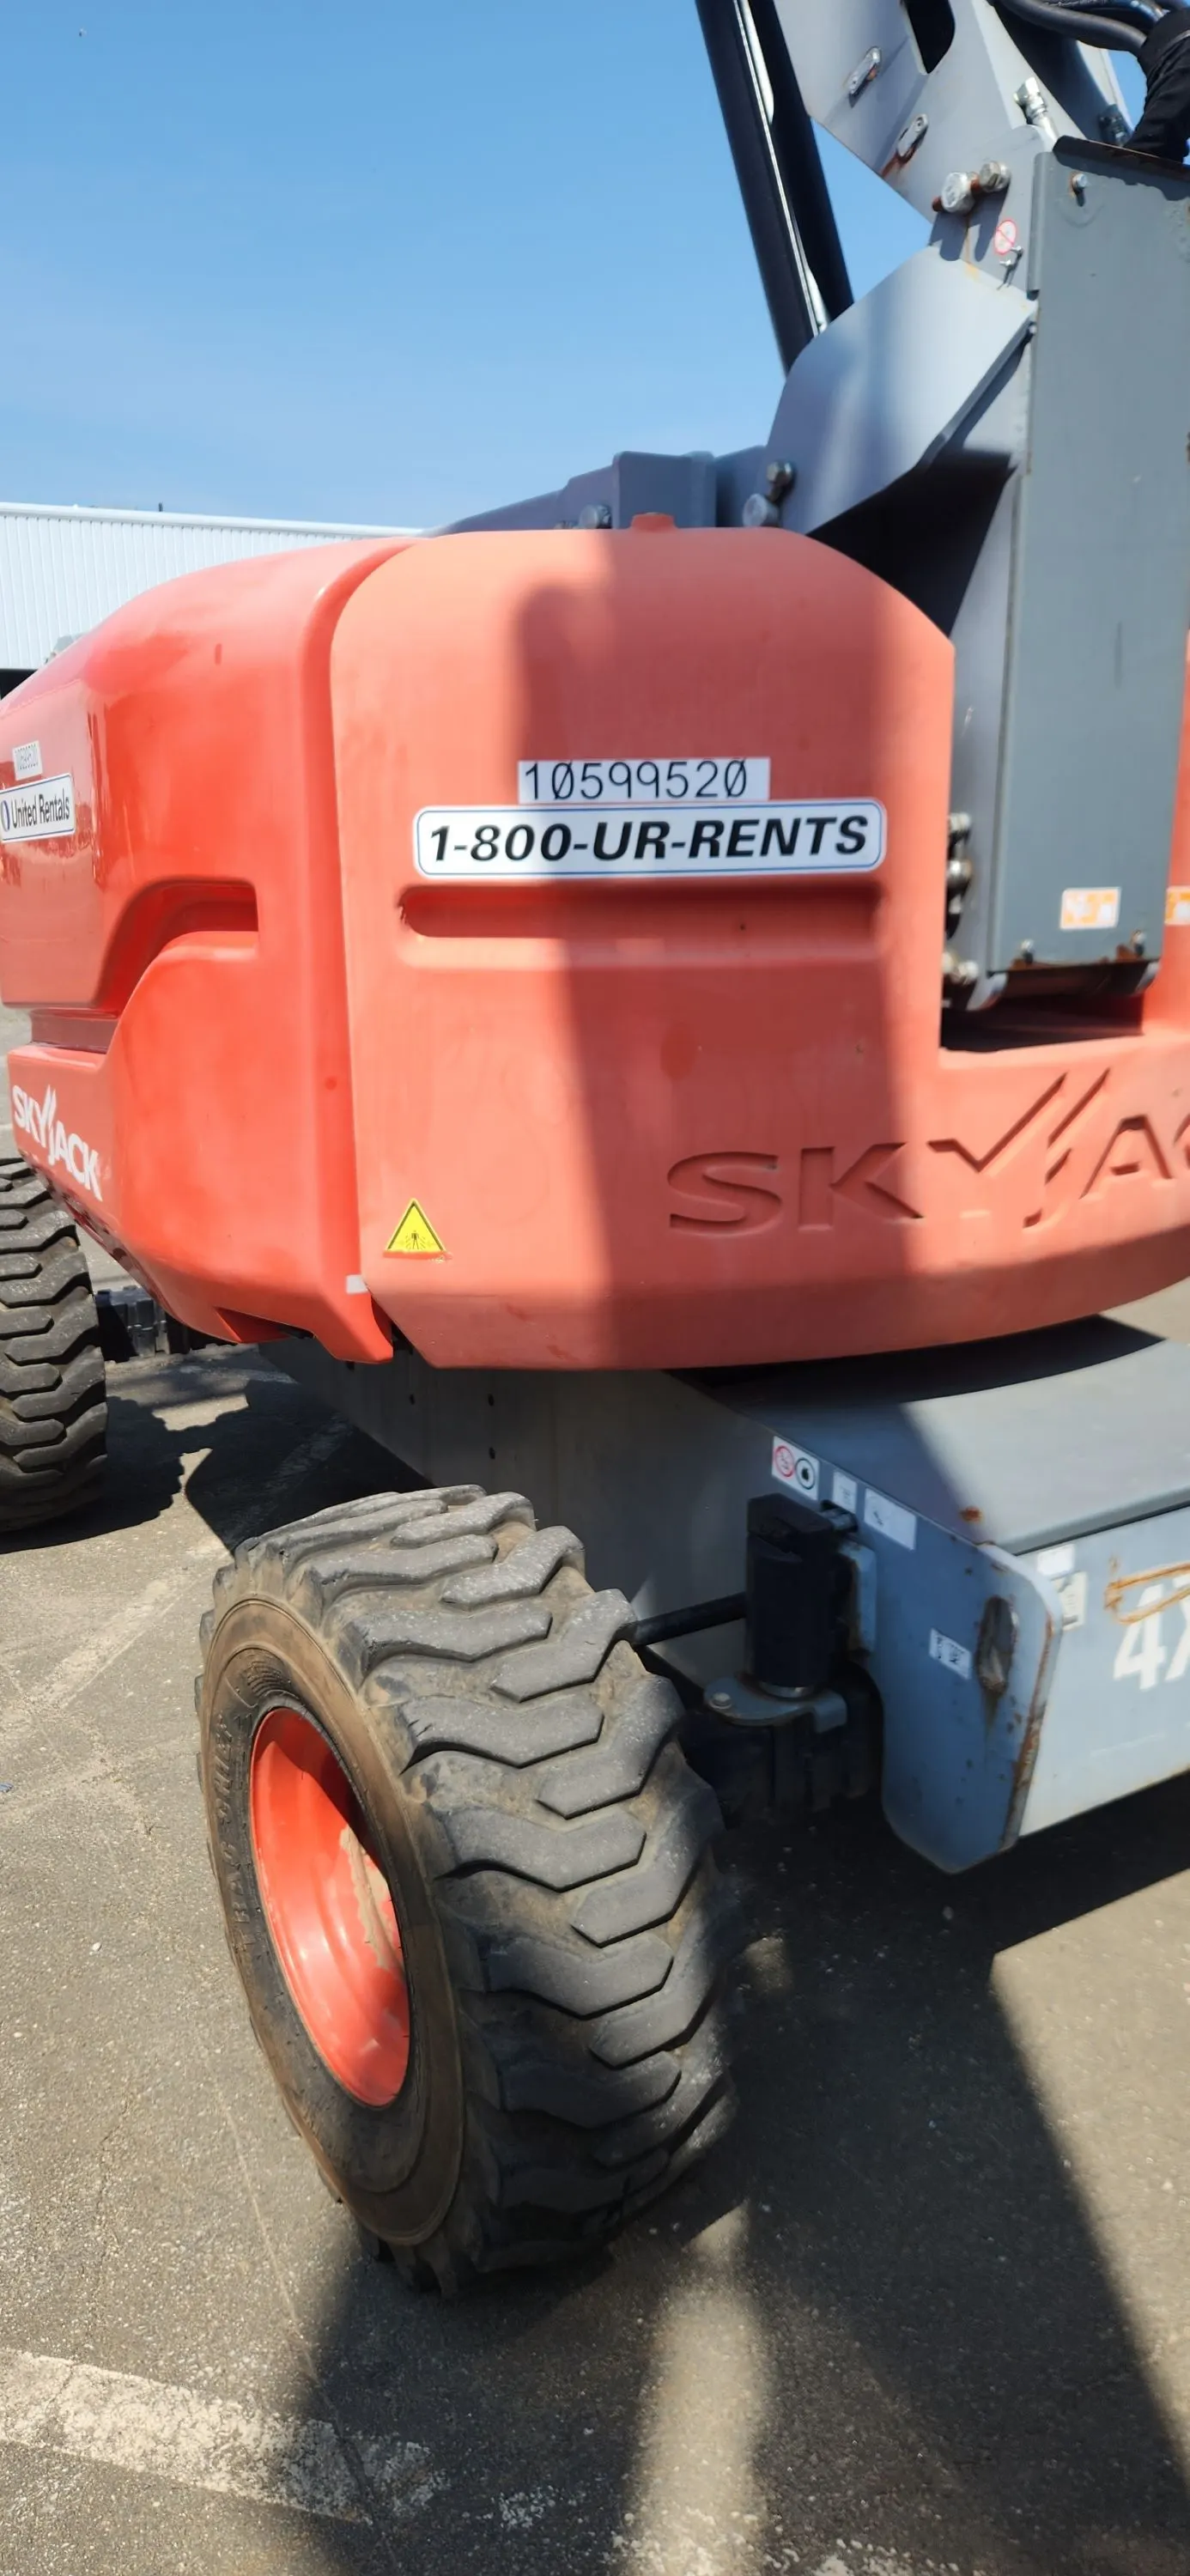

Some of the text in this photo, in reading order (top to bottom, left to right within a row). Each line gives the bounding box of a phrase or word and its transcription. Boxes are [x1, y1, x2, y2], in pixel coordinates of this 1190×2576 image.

[524, 756, 749, 801] 10599520
[11, 787, 70, 829] United Rentals
[429, 815, 869, 862] 1-800-UR-RENTS
[12, 1084, 104, 1202] SKYJACK
[666, 1065, 1190, 1236] SKYJA
